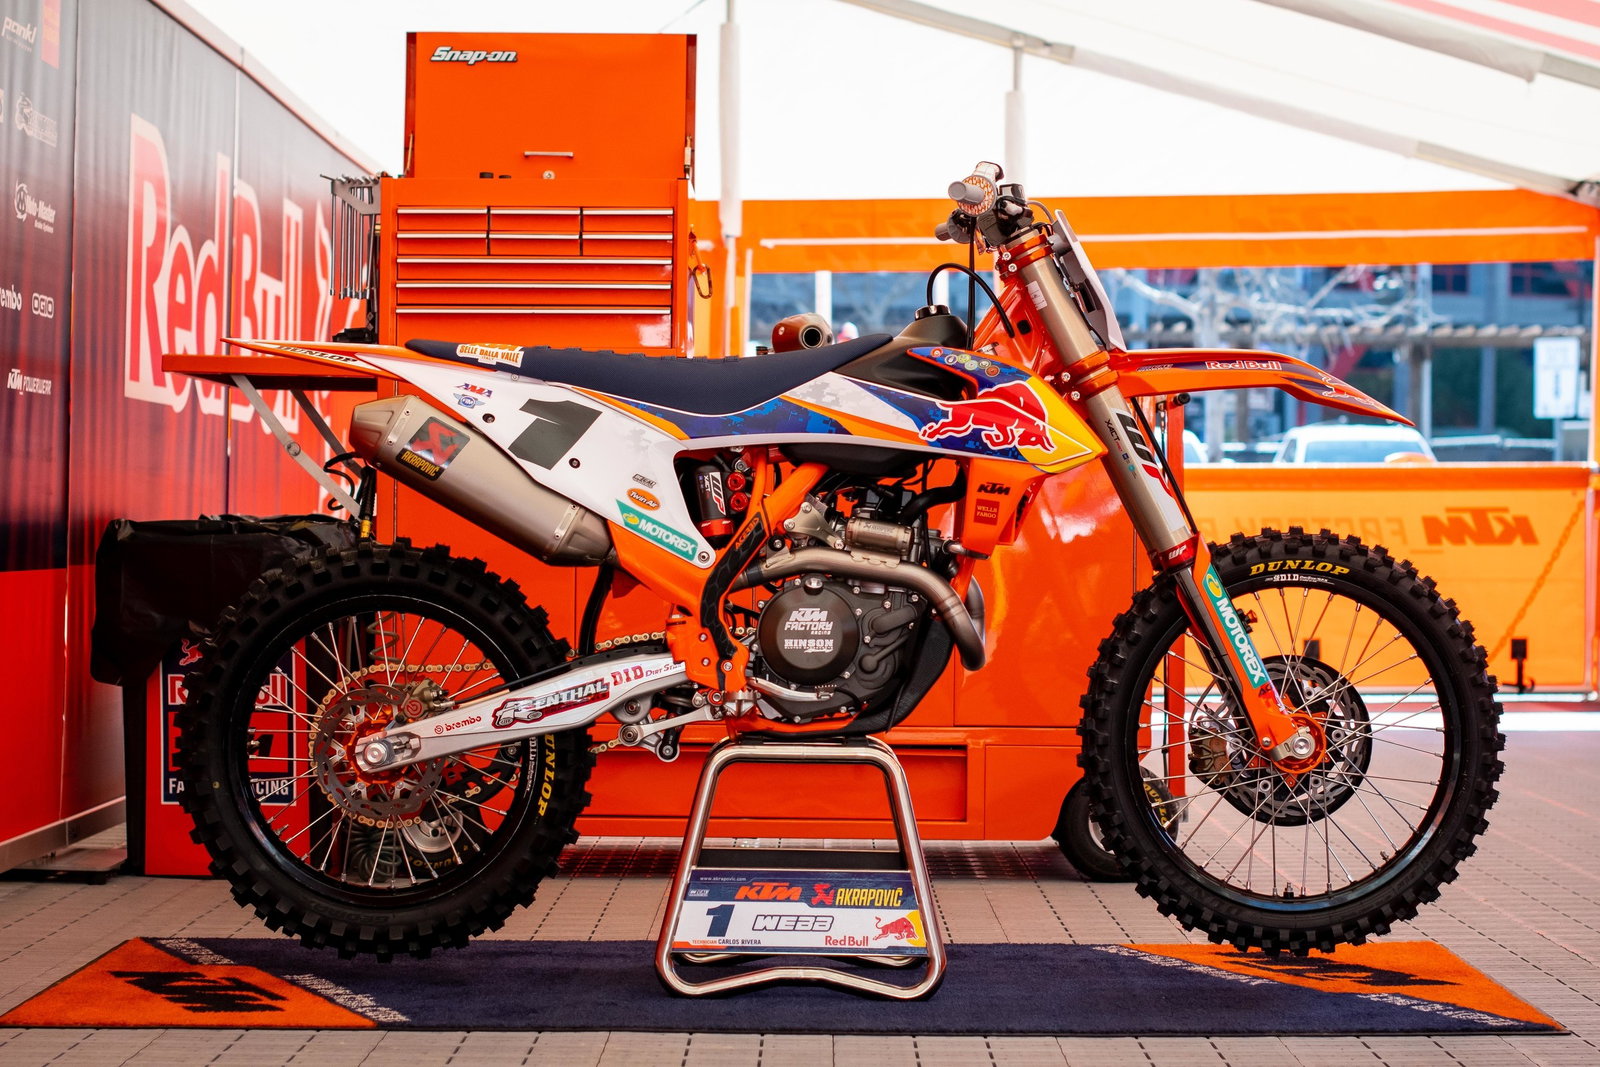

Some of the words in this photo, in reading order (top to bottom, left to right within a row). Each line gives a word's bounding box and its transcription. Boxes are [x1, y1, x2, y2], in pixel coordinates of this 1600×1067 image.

[430, 46, 518, 65] Snap-on
[124, 112, 231, 418] Red
[230, 176, 303, 435] Bull
[277, 345, 358, 362] DUNLOP
[460, 345, 478, 355] SELLE
[480, 348, 498, 358] DALLA
[501, 351, 520, 363] VALLE
[1205, 360, 1245, 370] Red
[1245, 360, 1283, 371] Bull
[508, 398, 603, 471] 1
[976, 481, 1011, 496] KTM
[630, 490, 647, 505] Twin
[645, 499, 658, 509] Air
[976, 511, 997, 519] FARGO
[977, 505, 998, 513] WELLS
[638, 518, 696, 555] MOTOREX
[1249, 560, 1350, 577] DUNLOP
[788, 607, 829, 622] KTM
[784, 621, 834, 631] FACTORY
[784, 638, 834, 647] HINSON
[1216, 597, 1266, 684] MOTOREX
[444, 715, 482, 732] brembo
[537, 733, 556, 817] UNLOP
[735, 882, 802, 901] KTM
[706, 904, 735, 938] 1
[752, 914, 835, 932] WEBB
[741, 938, 762, 946] RIVERA
[825, 935, 847, 946] Red
[848, 936, 869, 947] Bull
